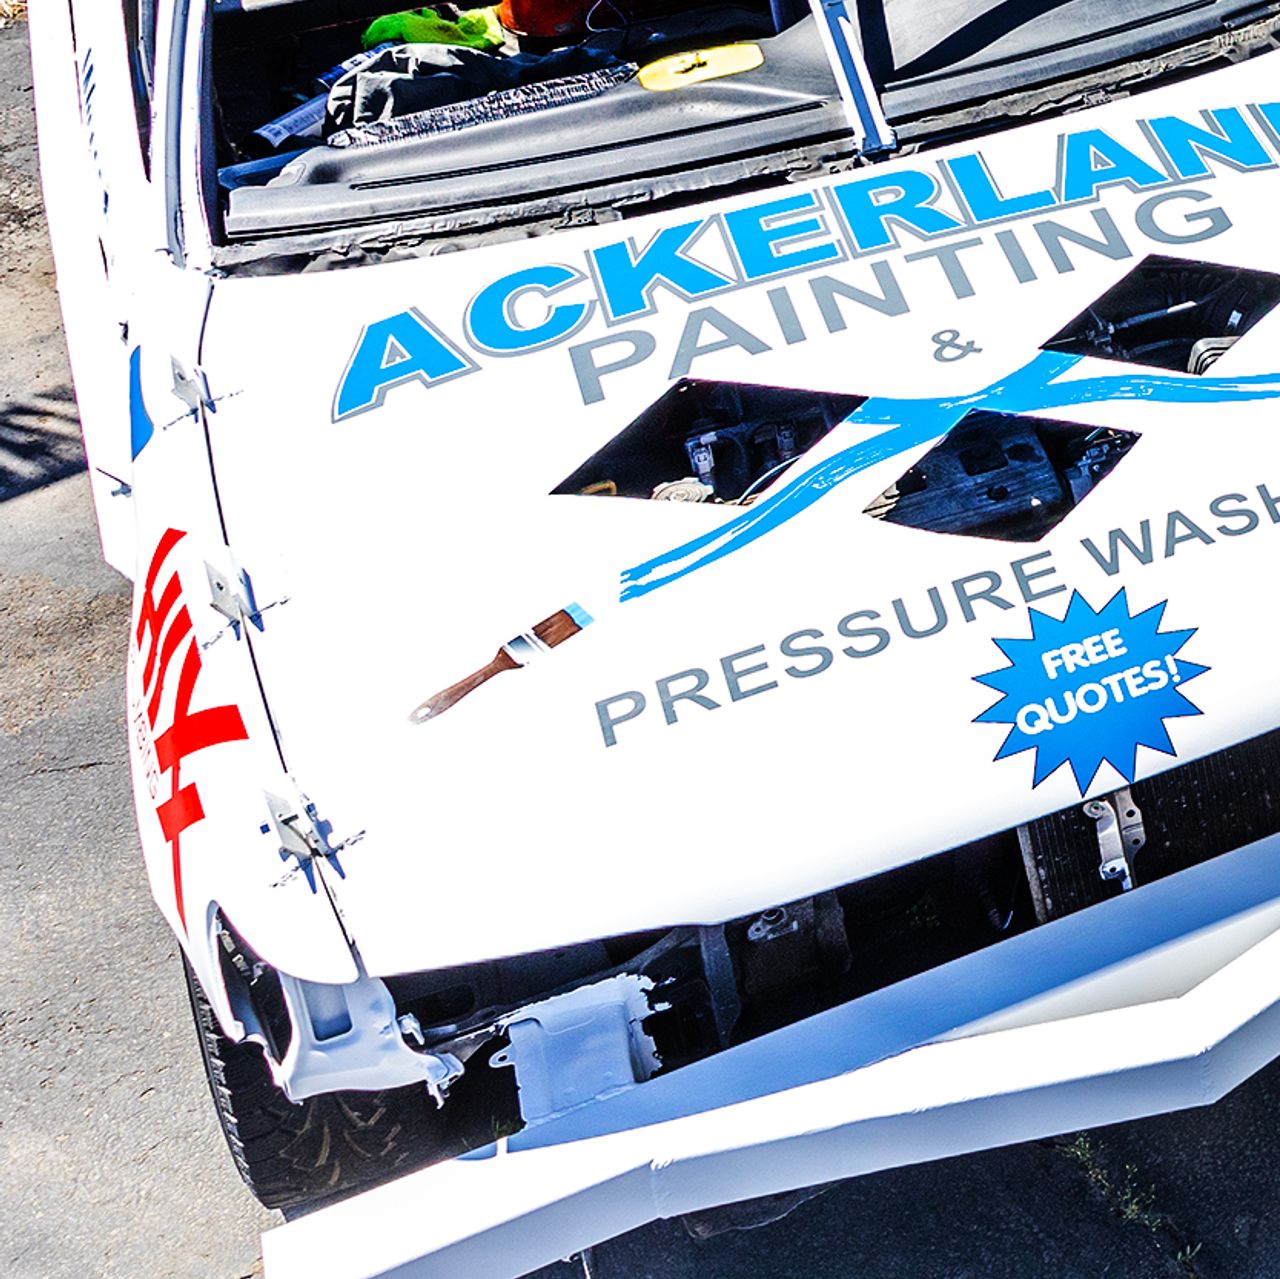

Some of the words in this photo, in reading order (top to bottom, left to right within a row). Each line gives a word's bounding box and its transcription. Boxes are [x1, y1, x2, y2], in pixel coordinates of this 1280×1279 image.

[567, 187, 1233, 408] PAINTING
[931, 327, 986, 365] &
[593, 548, 1068, 750] PRESSURE
[1040, 625, 1130, 682] FREE
[1014, 655, 1181, 738] QUOTES!
